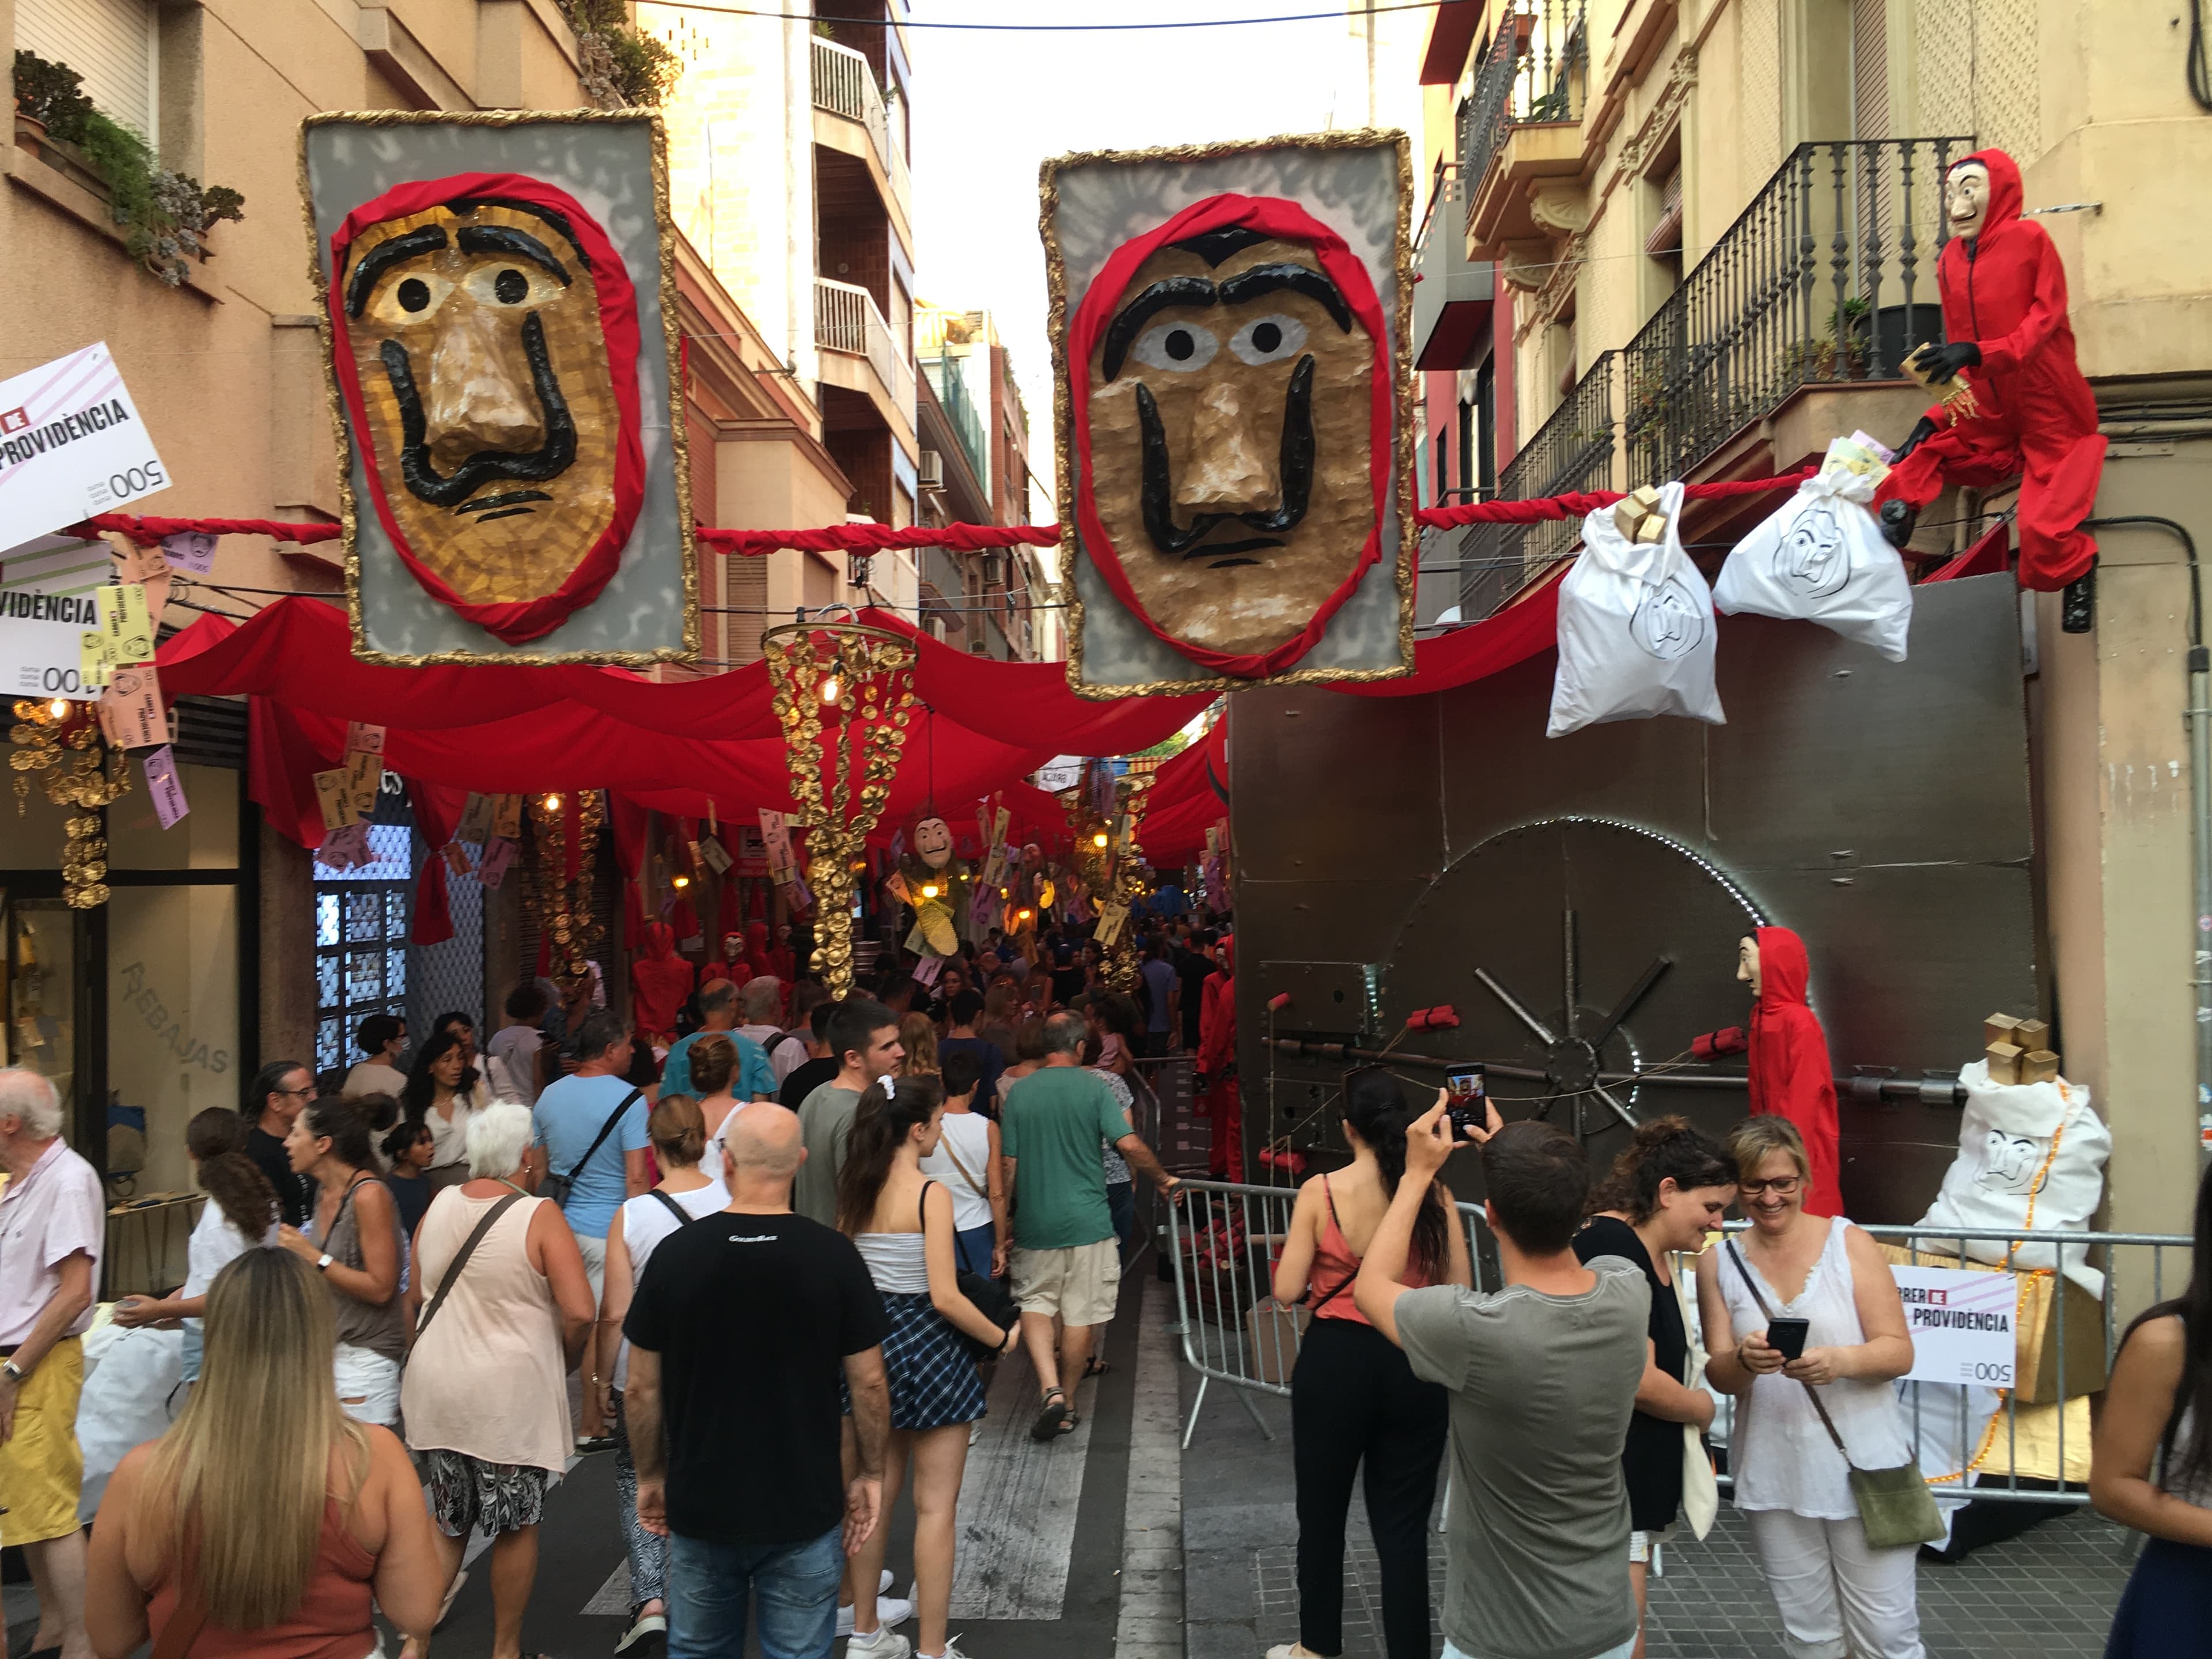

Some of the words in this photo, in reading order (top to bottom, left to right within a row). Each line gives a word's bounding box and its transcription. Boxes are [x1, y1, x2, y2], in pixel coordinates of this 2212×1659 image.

[0, 398, 130, 470] ROVIDÈNCIA
[120, 961, 228, 1074] REBAJAS
[1913, 1308, 2009, 1332] PROVIDÈNCIA
